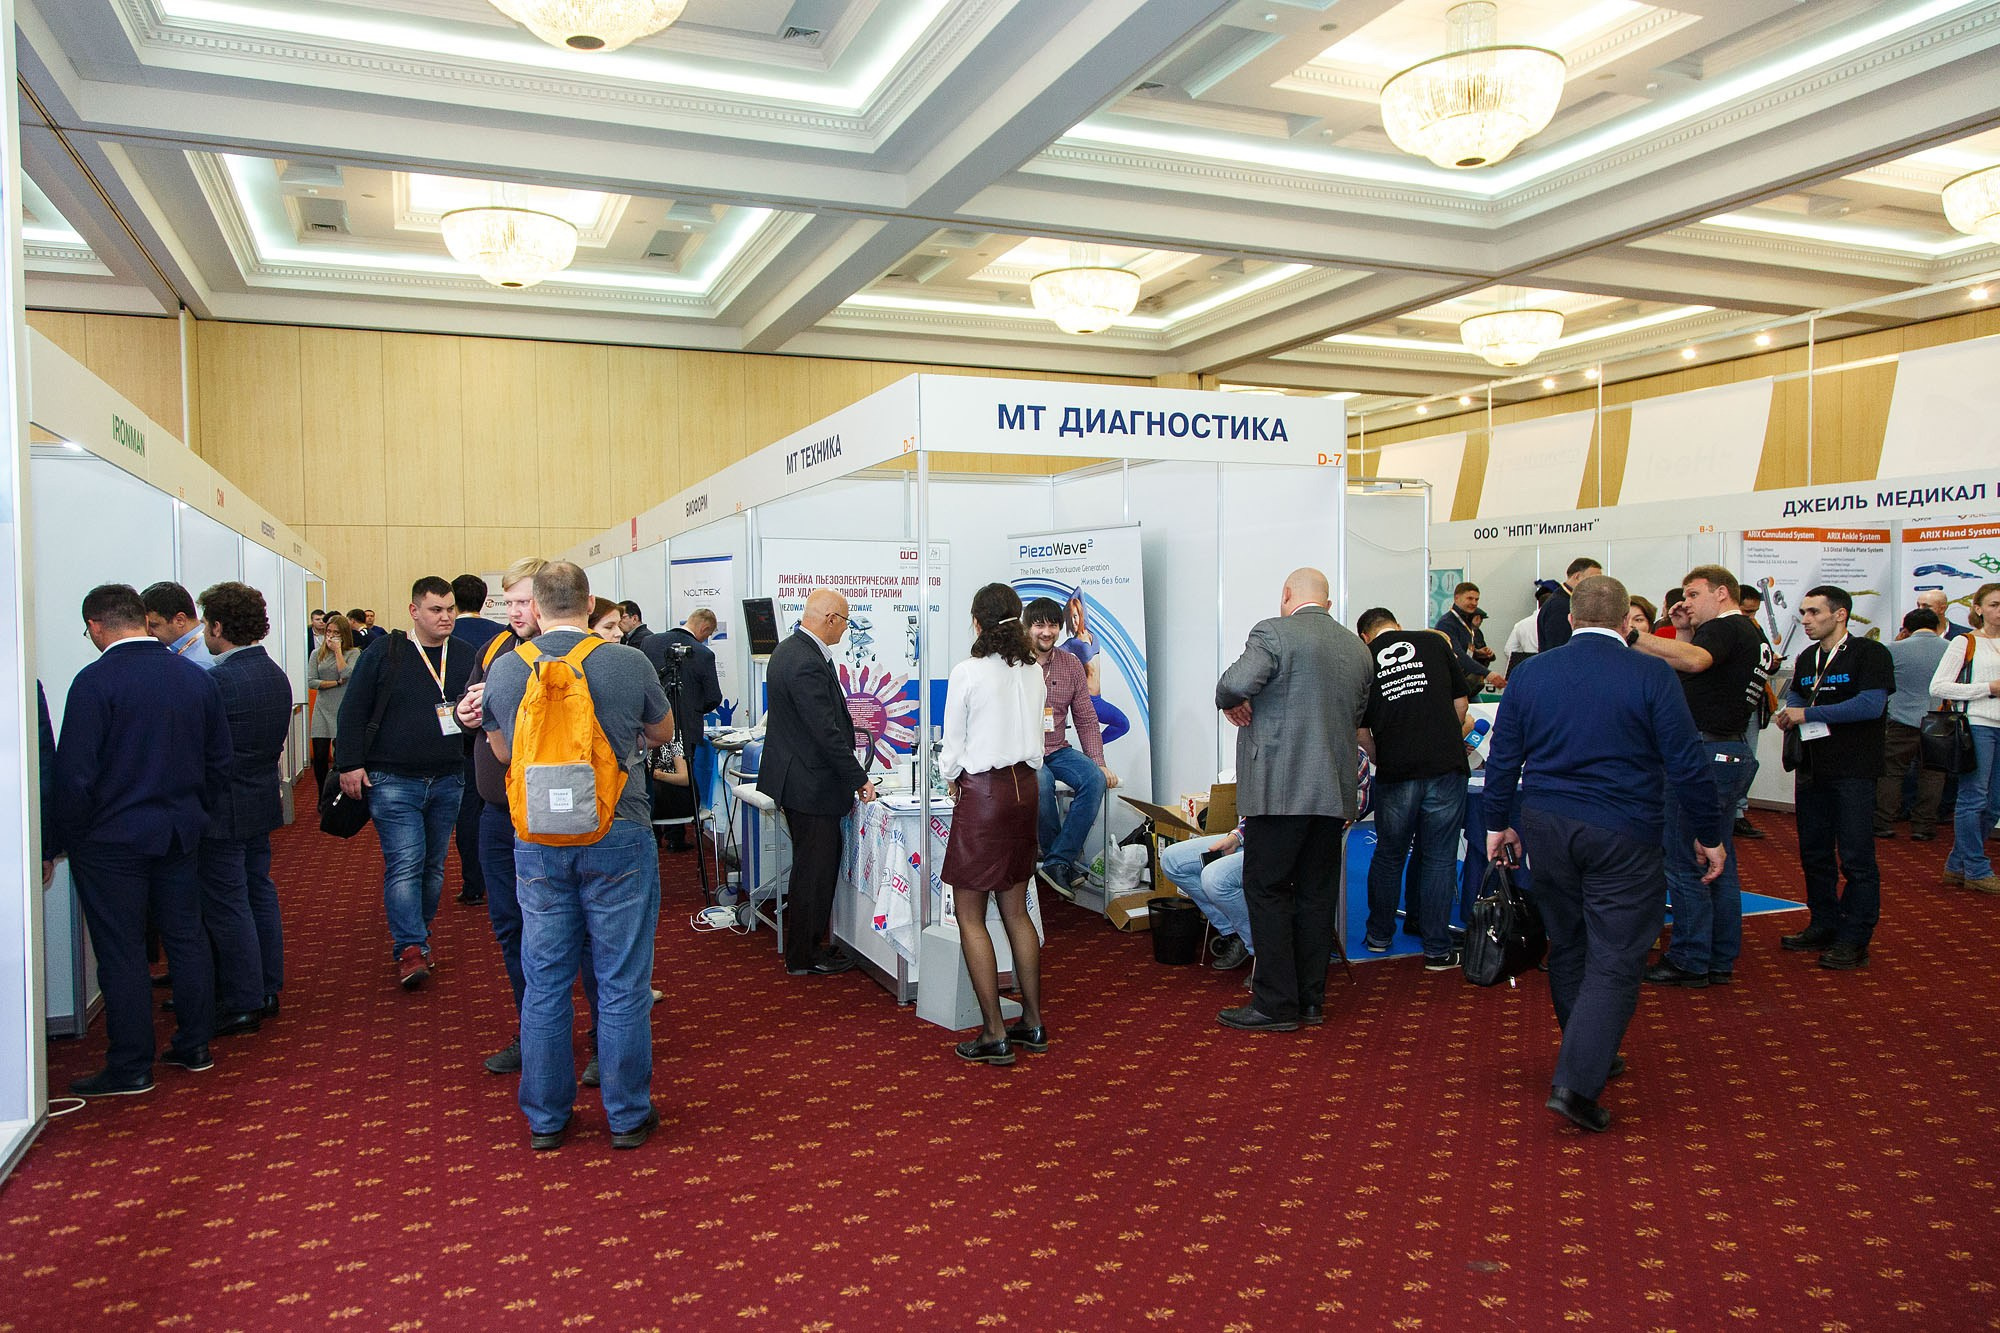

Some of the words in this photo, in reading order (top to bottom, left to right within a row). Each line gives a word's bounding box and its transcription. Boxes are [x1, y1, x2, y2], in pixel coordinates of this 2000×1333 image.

[997, 403, 1046, 431] МТ
[1058, 406, 1289, 442] ДИАГНОСТИКА
[112, 413, 145, 457] IRONMAN
[903, 436, 915, 453] D-7
[786, 451, 798, 475] МТ
[800, 434, 842, 469] ТЕХНИКА
[1317, 453, 1342, 467] D-7
[685, 493, 708, 518] БИОФОРМ
[1783, 495, 1868, 518] ДЖЕИЛЬ
[1877, 483, 1986, 508] МЕДИКАЛ
[1473, 527, 1499, 540] ООО
[1794, 531, 1815, 540] System
[1827, 532, 1841, 540] ARIX
[1859, 533, 1880, 542] System
[1920, 531, 1941, 539] ARIX
[1942, 529, 1966, 538] Hand
[1967, 527, 2000, 538] System
[1055, 565, 1081, 574] Shockwave
[1081, 563, 1110, 573] Generation
[778, 573, 813, 585] ЛИНЕЙКА
[815, 575, 898, 586] ПЬЕЗОЭЛЕКТРИЧЕСКИХ
[1101, 577, 1113, 585] без
[1114, 576, 1130, 584] боли
[683, 588, 721, 597] NOLTREX
[778, 588, 795, 598] ДЛЯ
[871, 588, 903, 598] ТЕРАПИИ
[1406, 680, 1428, 688] ПОРТАЛ
